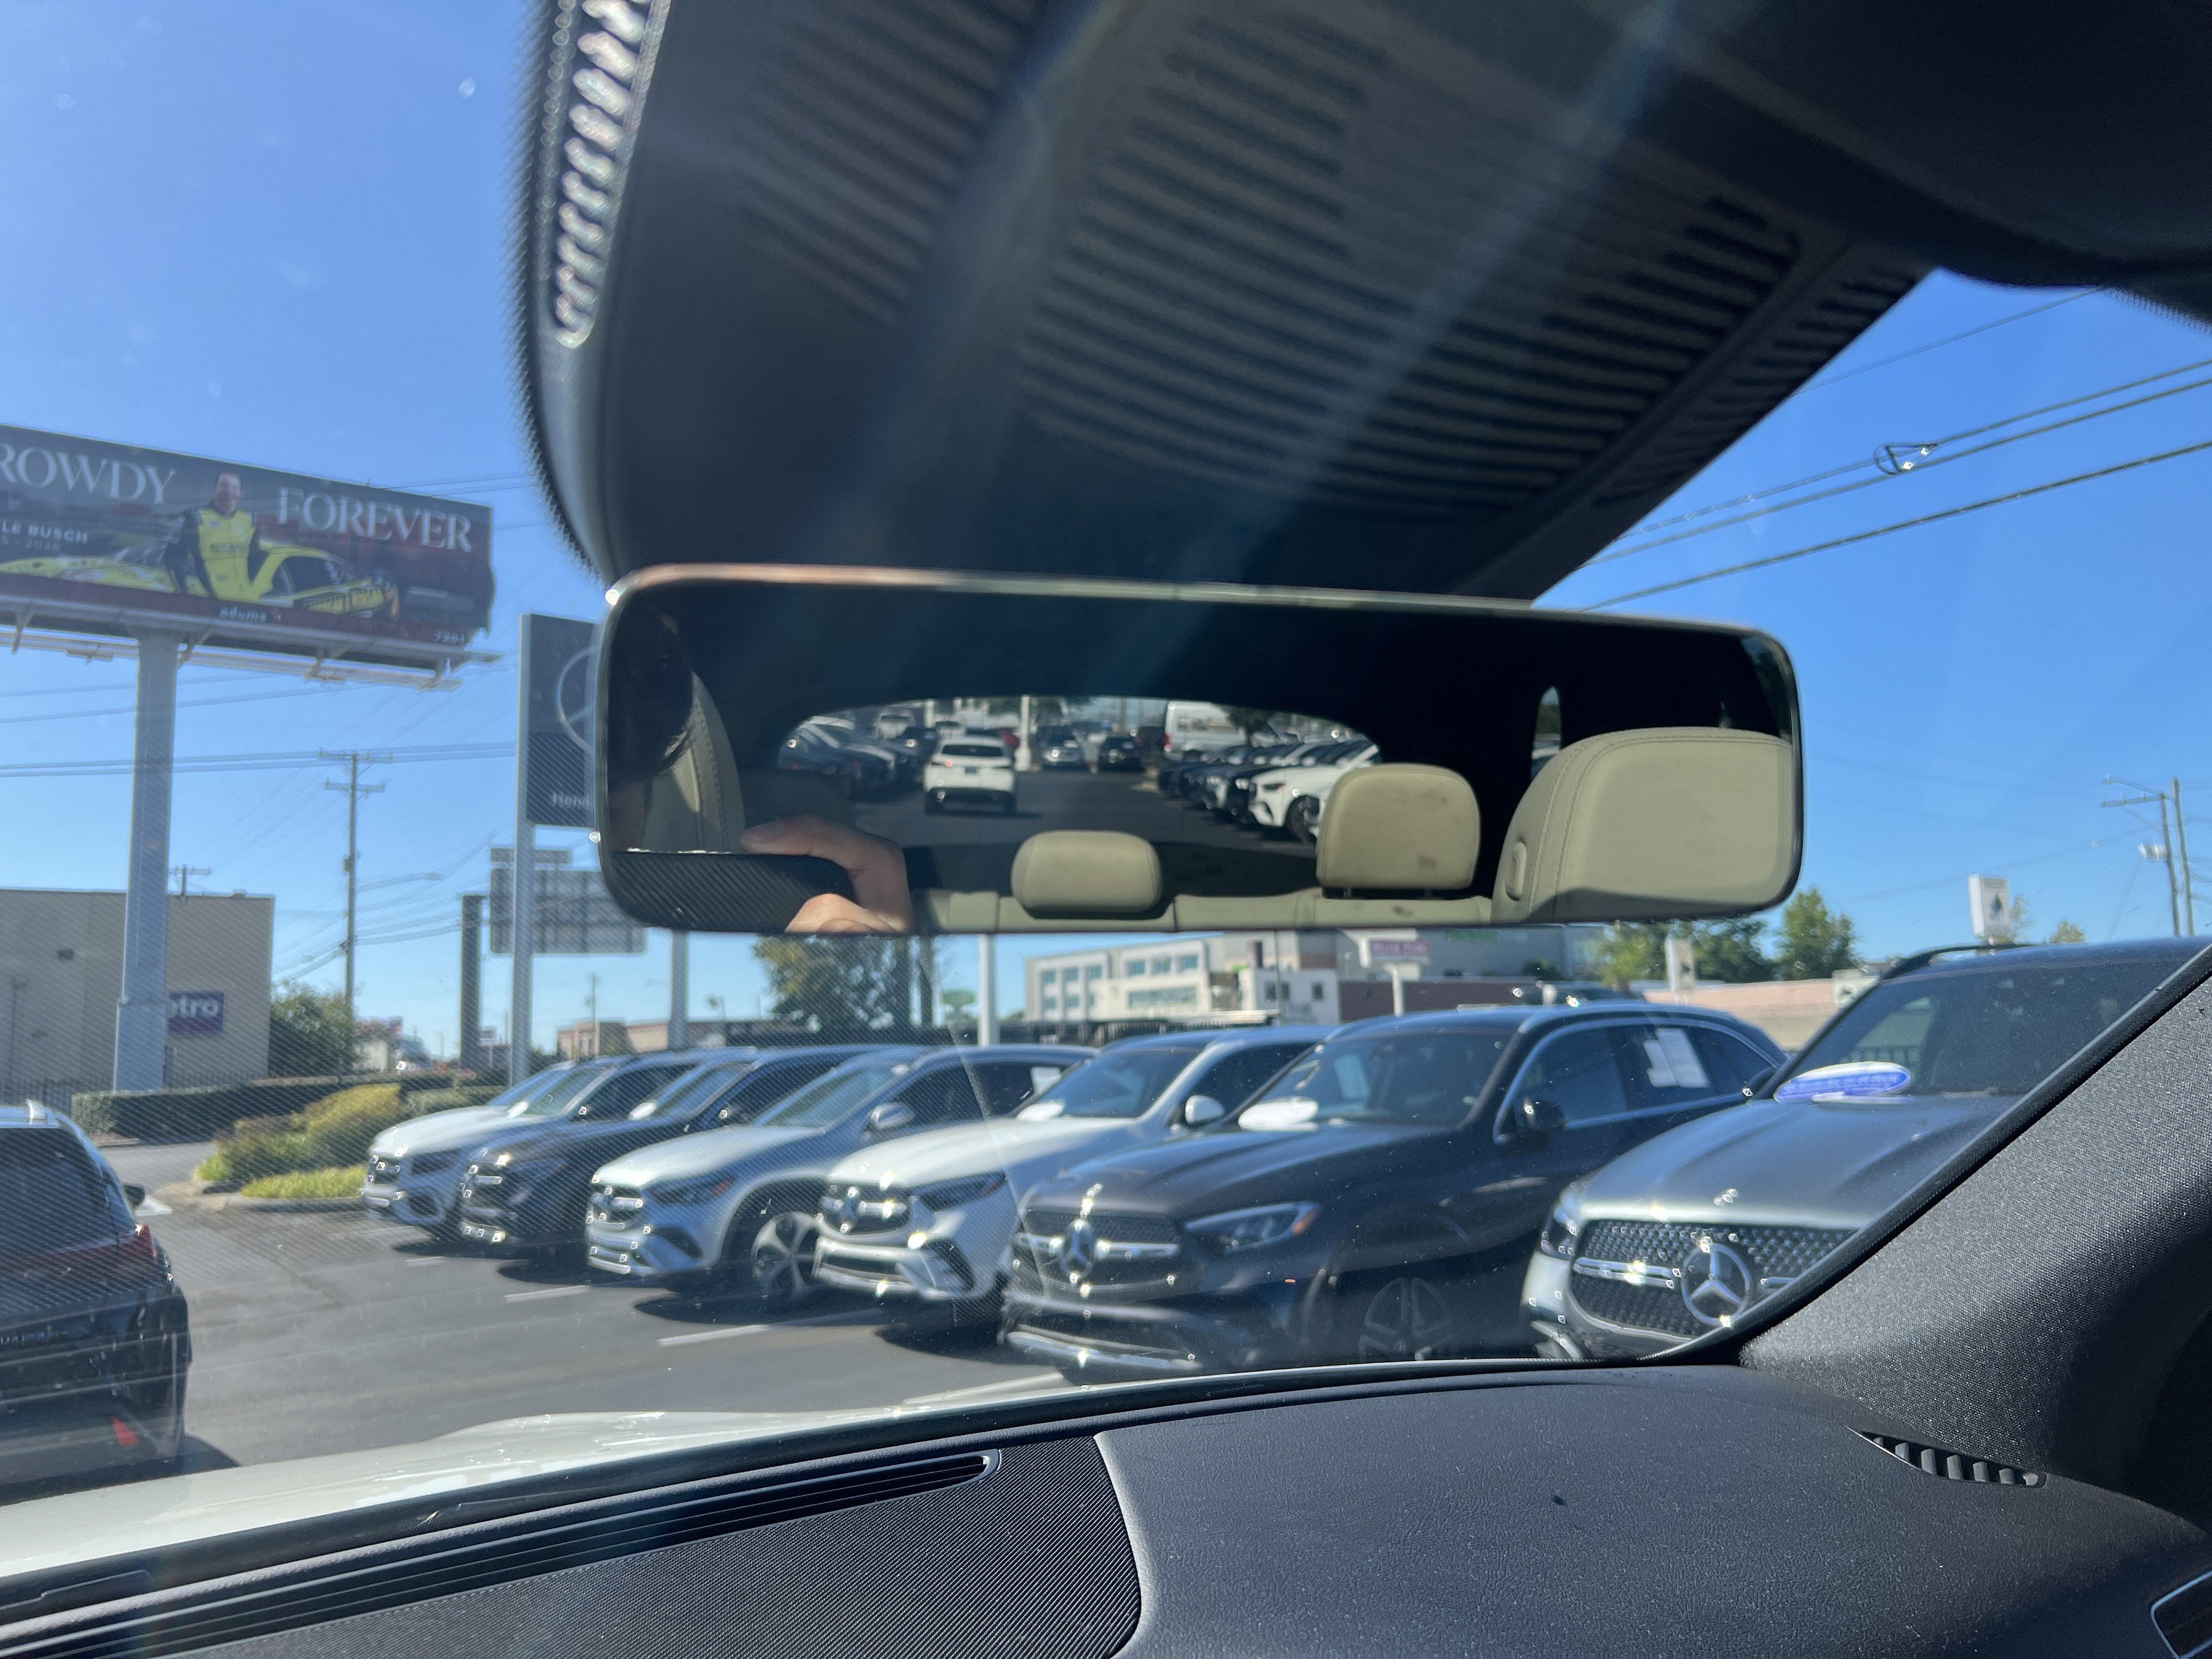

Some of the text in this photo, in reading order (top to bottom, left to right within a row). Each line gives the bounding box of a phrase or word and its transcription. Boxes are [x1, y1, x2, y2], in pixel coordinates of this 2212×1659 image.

[0, 442, 473, 553] ROWDY FOREVER
[28, 524, 88, 544] BUSCH
